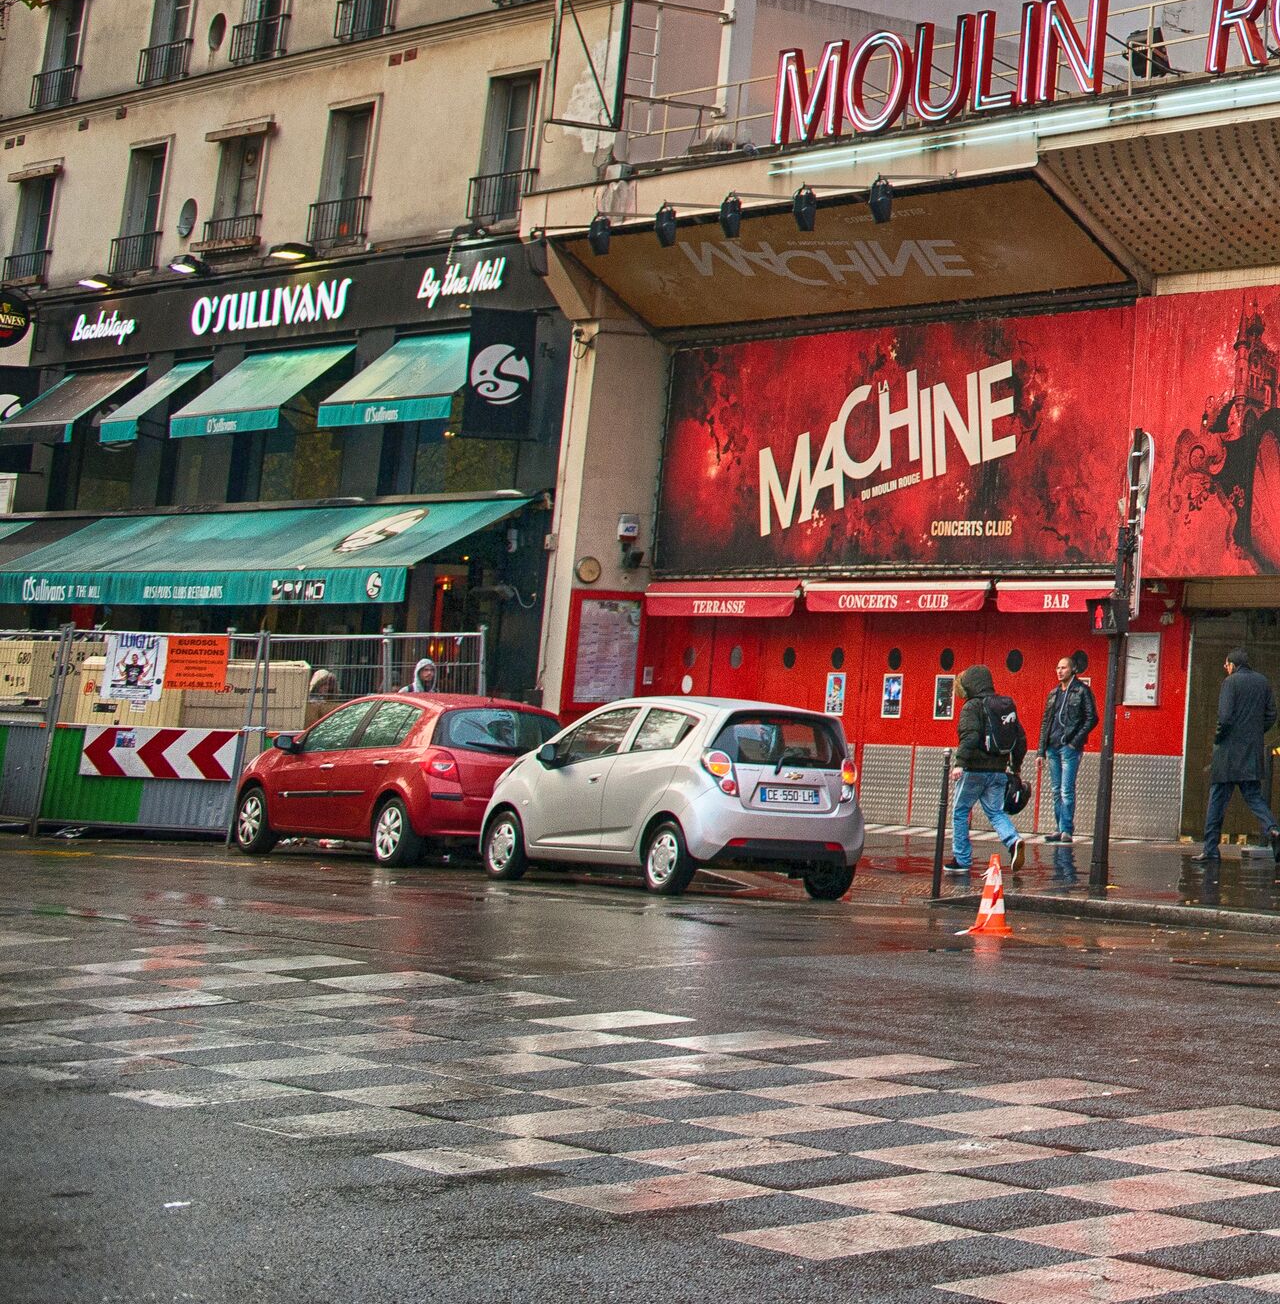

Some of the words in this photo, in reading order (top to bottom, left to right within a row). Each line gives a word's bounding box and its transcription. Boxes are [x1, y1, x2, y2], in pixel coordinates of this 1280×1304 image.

[417, 267, 443, 308] By
[440, 263, 467, 295] the
[467, 256, 507, 294] Mill
[191, 277, 353, 336] O'SULLIVANS
[71, 309, 136, 346] Backstage
[878, 379, 889, 394] LA
[759, 359, 1017, 537] MACHINE
[861, 488, 871, 501] DU
[871, 479, 897, 498] MOULIN
[898, 472, 921, 490] ROUGE
[931, 520, 983, 537] CONCERTS
[984, 520, 1013, 537] CLUB
[692, 600, 746, 614] TERRASSE
[838, 594, 898, 609] CONCERTS
[918, 593, 949, 608] CLUB
[1043, 594, 1070, 609] BAR
